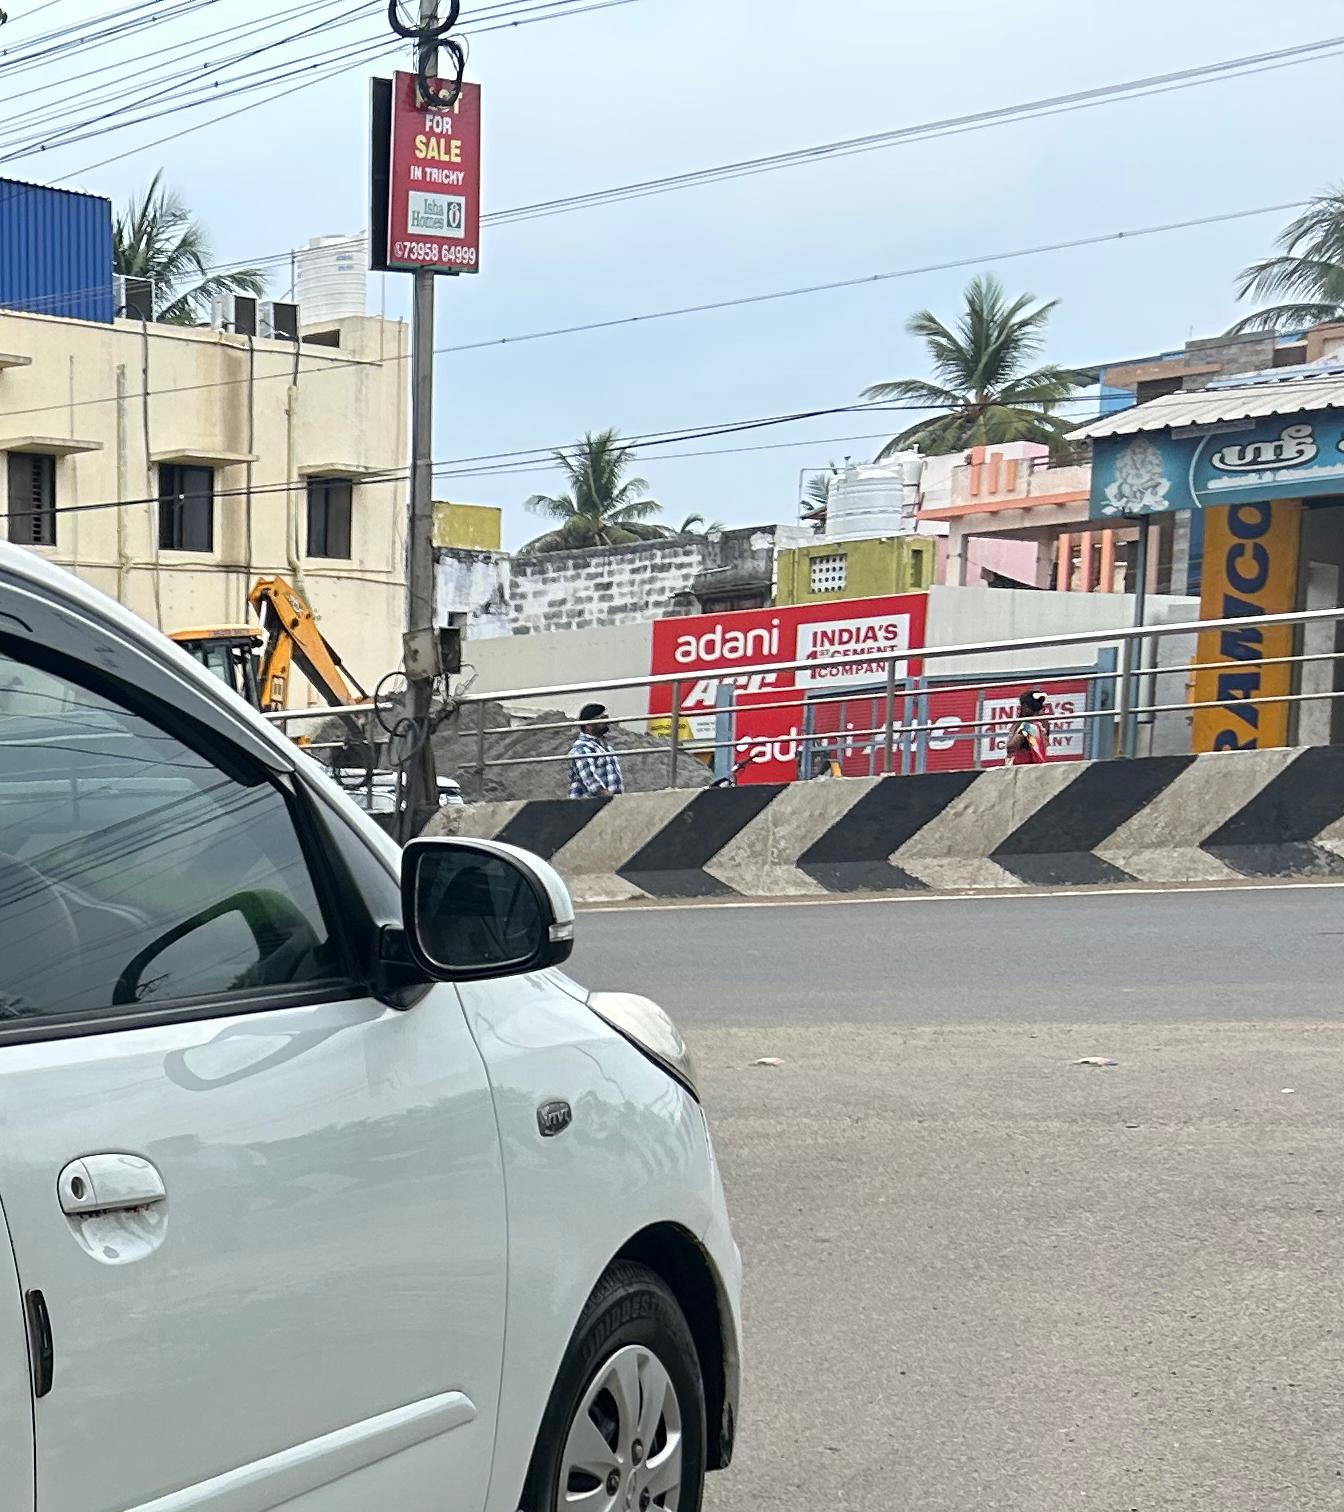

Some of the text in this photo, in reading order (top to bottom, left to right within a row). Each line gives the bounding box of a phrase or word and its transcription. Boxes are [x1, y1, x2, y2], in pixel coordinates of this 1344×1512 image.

[425, 114, 452, 135] FOR
[415, 134, 462, 163] SALE
[410, 165, 465, 186] IN TRICHY
[424, 199, 444, 216] Isha
[411, 210, 445, 230] Homes
[403, 242, 476, 265] 73958 64999
[674, 618, 780, 663] adani
[811, 623, 898, 649] INDIA'S
[818, 661, 887, 678] COMPAN
